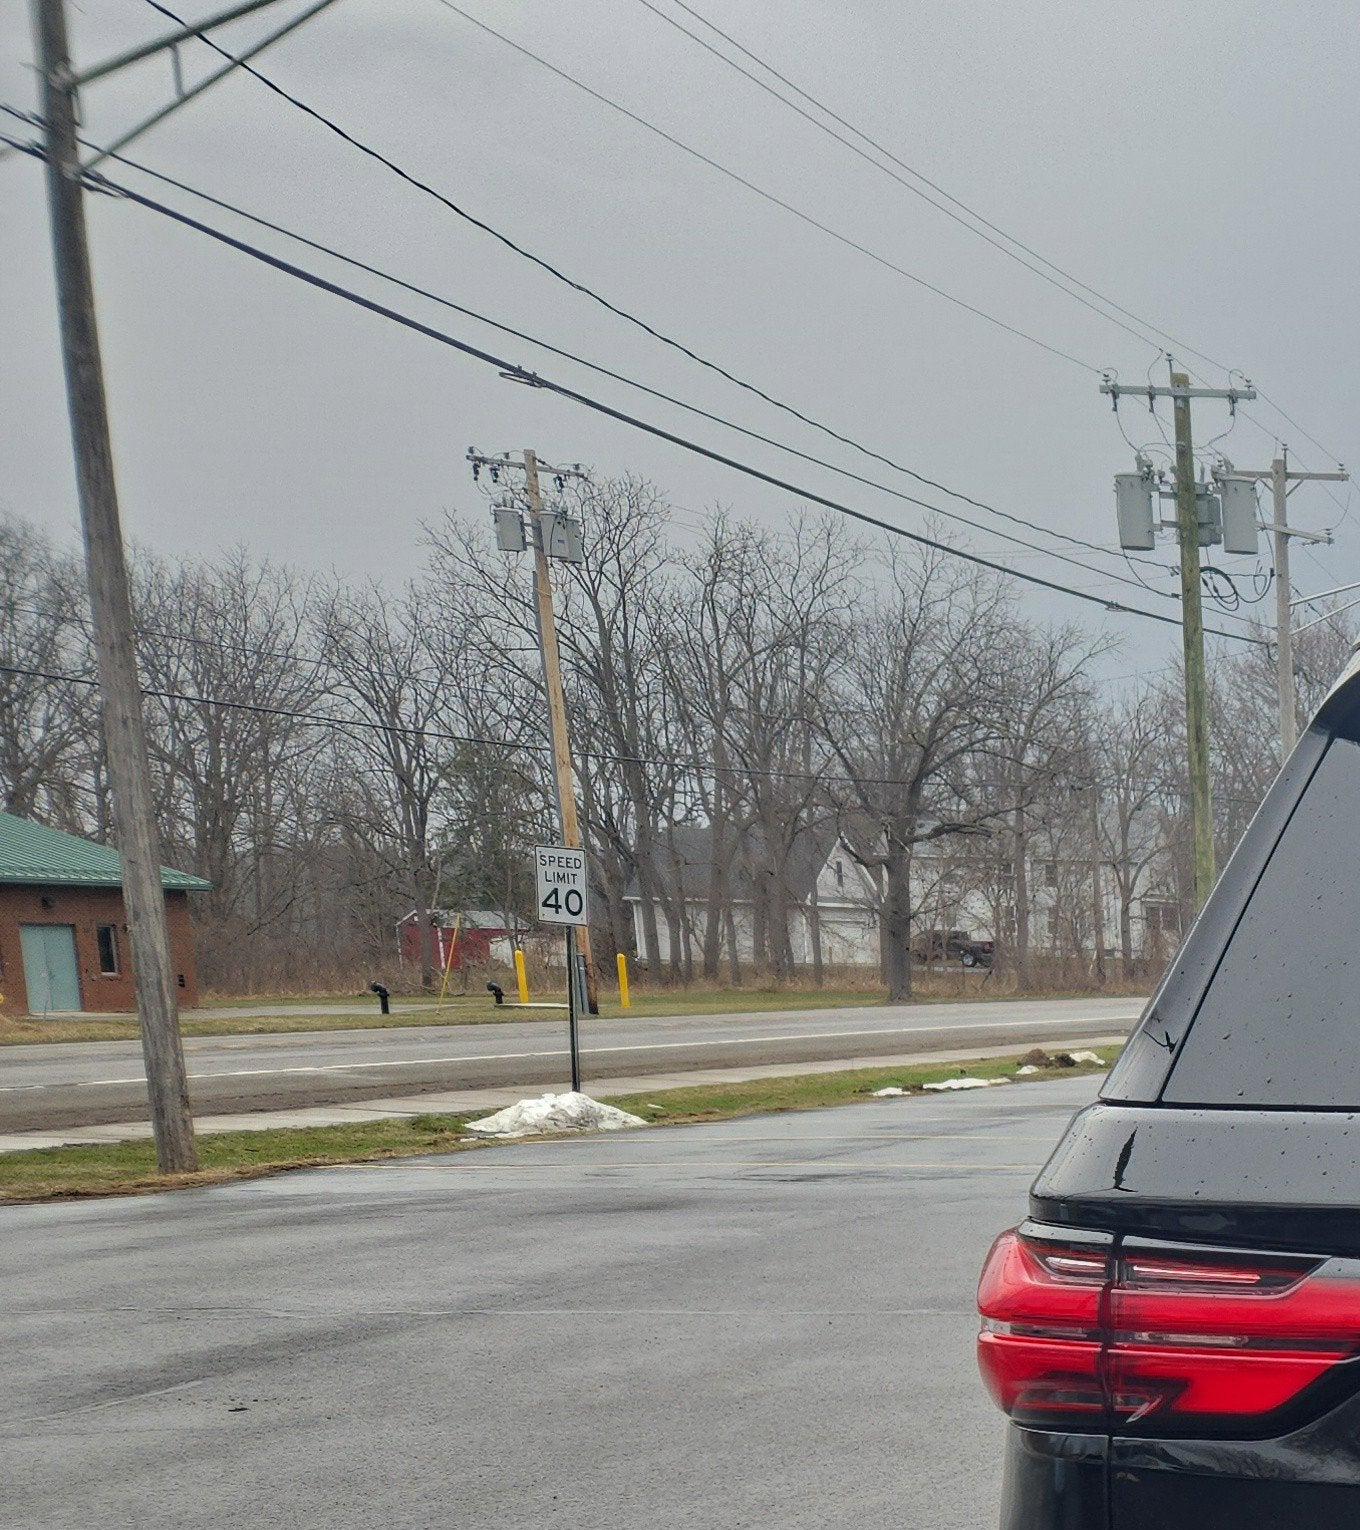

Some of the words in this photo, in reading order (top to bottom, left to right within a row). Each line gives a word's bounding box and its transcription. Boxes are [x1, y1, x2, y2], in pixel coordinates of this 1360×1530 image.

[539, 854, 582, 870] SPEED
[544, 870, 578, 885] LIMIT
[541, 887, 583, 916] 40
